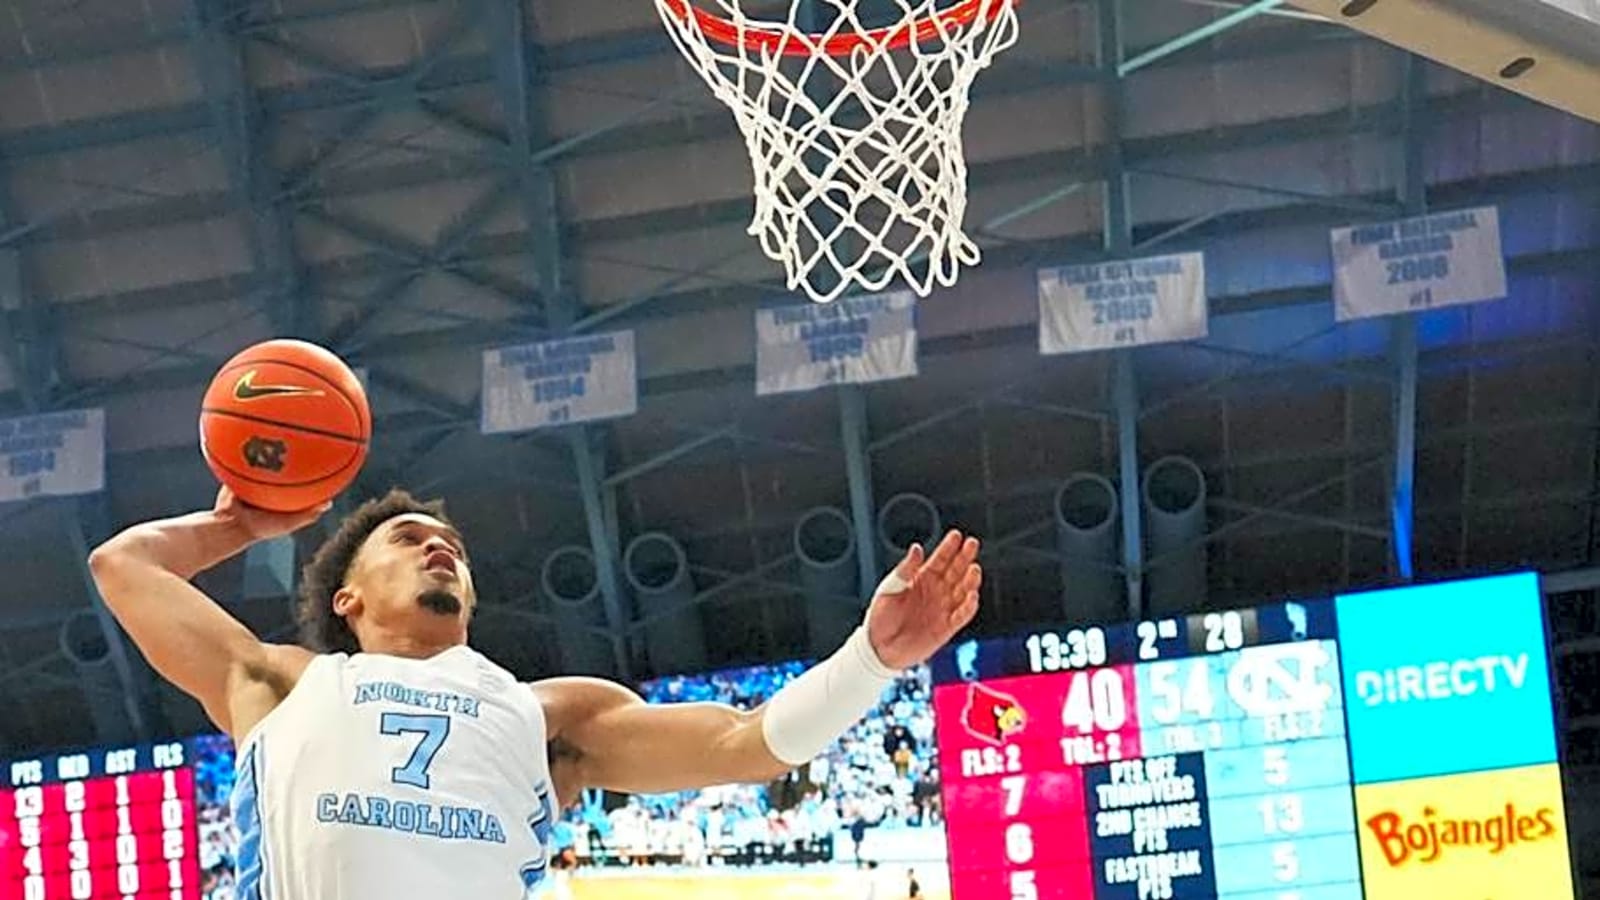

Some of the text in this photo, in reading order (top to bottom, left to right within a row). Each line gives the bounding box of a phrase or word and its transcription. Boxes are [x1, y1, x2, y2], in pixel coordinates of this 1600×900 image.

[353, 680, 481, 718] NORTH
[1150, 662, 1213, 726] 54
[1355, 652, 1529, 707] DIRECTV
[1061, 668, 1127, 734] 40
[11, 760, 43, 785] PTS
[105, 748, 137, 775] AST
[153, 742, 184, 768] FLS
[380, 712, 451, 790] 7
[961, 744, 1022, 776] FLS: 2
[1104, 733, 1122, 761] 2
[1110, 759, 1144, 784] PTS
[1263, 748, 1291, 787] 5
[64, 780, 86, 812] 2
[115, 775, 130, 806] 1
[162, 770, 178, 800] 1
[1001, 775, 1027, 817] 7
[1096, 775, 1196, 809] TURNOVERS
[70, 812, 85, 841] 1
[116, 806, 133, 835] 1
[161, 799, 183, 829] 0
[316, 793, 507, 844] CAROLINA
[1095, 801, 1202, 837] 2ND CHANCE
[1259, 795, 1304, 835] 13
[1366, 802, 1556, 868] Bojangles
[22, 829, 185, 875] 4 3 0 2
[1005, 823, 1034, 863] 6
[1133, 828, 1169, 854] PTS
[70, 869, 92, 900] 0
[117, 864, 139, 895] 0
[168, 859, 183, 889] 1
[1104, 849, 1202, 884] FASTBREAK
[1273, 845, 1300, 883] 5
[1138, 876, 1173, 900] PTS
